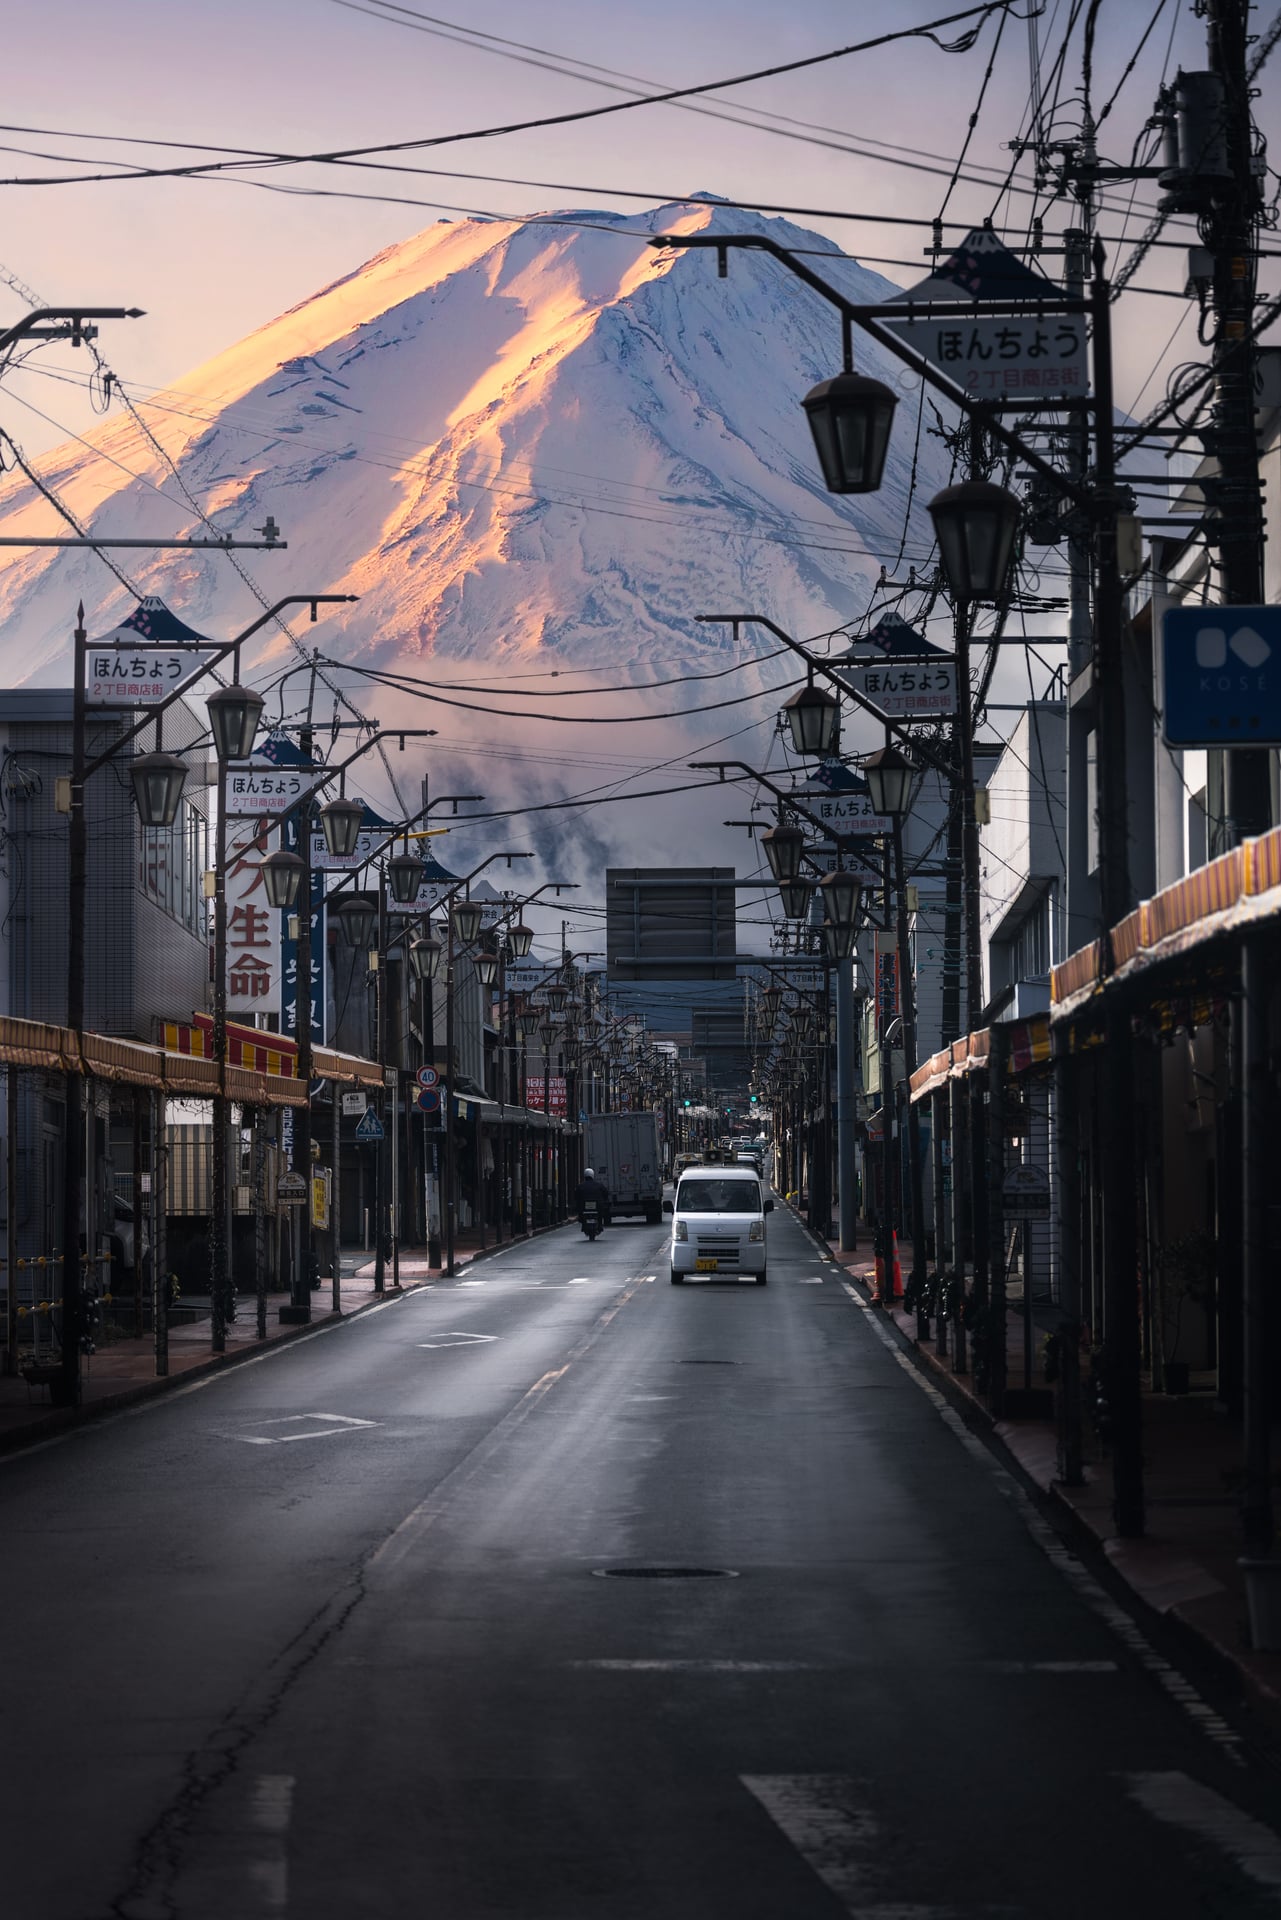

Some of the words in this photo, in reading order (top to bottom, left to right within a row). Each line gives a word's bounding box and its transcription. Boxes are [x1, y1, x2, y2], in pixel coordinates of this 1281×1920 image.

[938, 325, 1078, 361] ほんちょう
[967, 367, 1080, 389] 2丁目商店街
[94, 657, 182, 678] ほんちょう
[94, 683, 164, 696] 2丁目商店街
[865, 670, 950, 692] ほんちょう
[883, 694, 952, 709] 2丁目商店街
[233, 777, 301, 795] ほんちょう
[232, 797, 287, 807] 2丁目商店街
[821, 801, 872, 818] ほんちょ
[422, 1071, 435, 1082] 40
